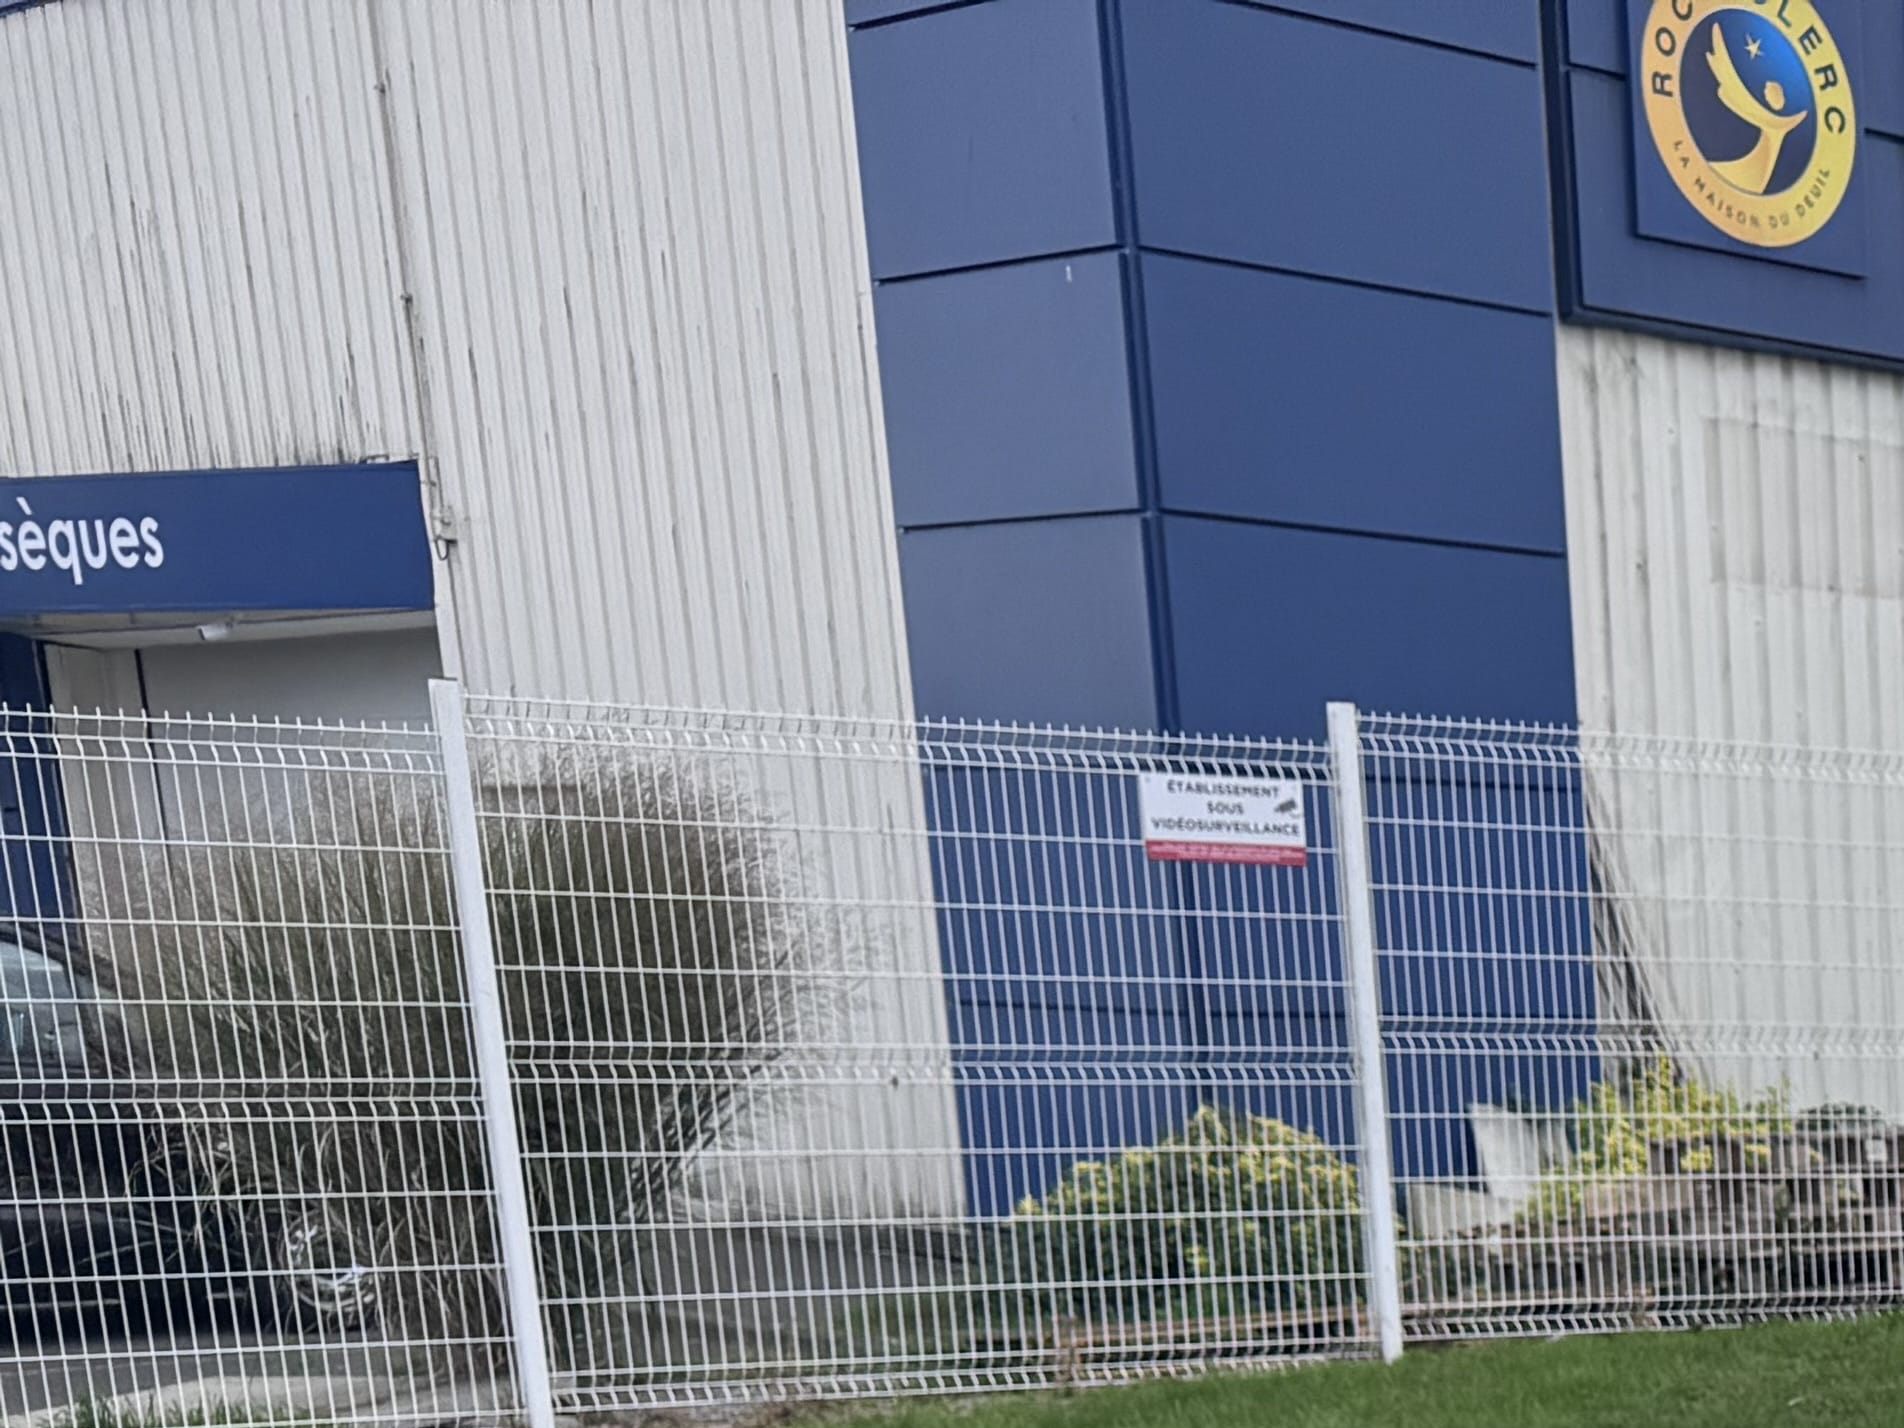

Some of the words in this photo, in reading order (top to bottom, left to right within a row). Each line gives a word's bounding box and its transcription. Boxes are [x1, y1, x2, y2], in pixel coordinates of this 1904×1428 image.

[1674, 140, 1690, 169] LA
[1695, 177, 1761, 228] MAISON
[1769, 214, 1790, 229] DU
[1796, 168, 1830, 217] DEUIL
[0, 497, 164, 585] sèques
[1207, 801, 1244, 815] SOUS
